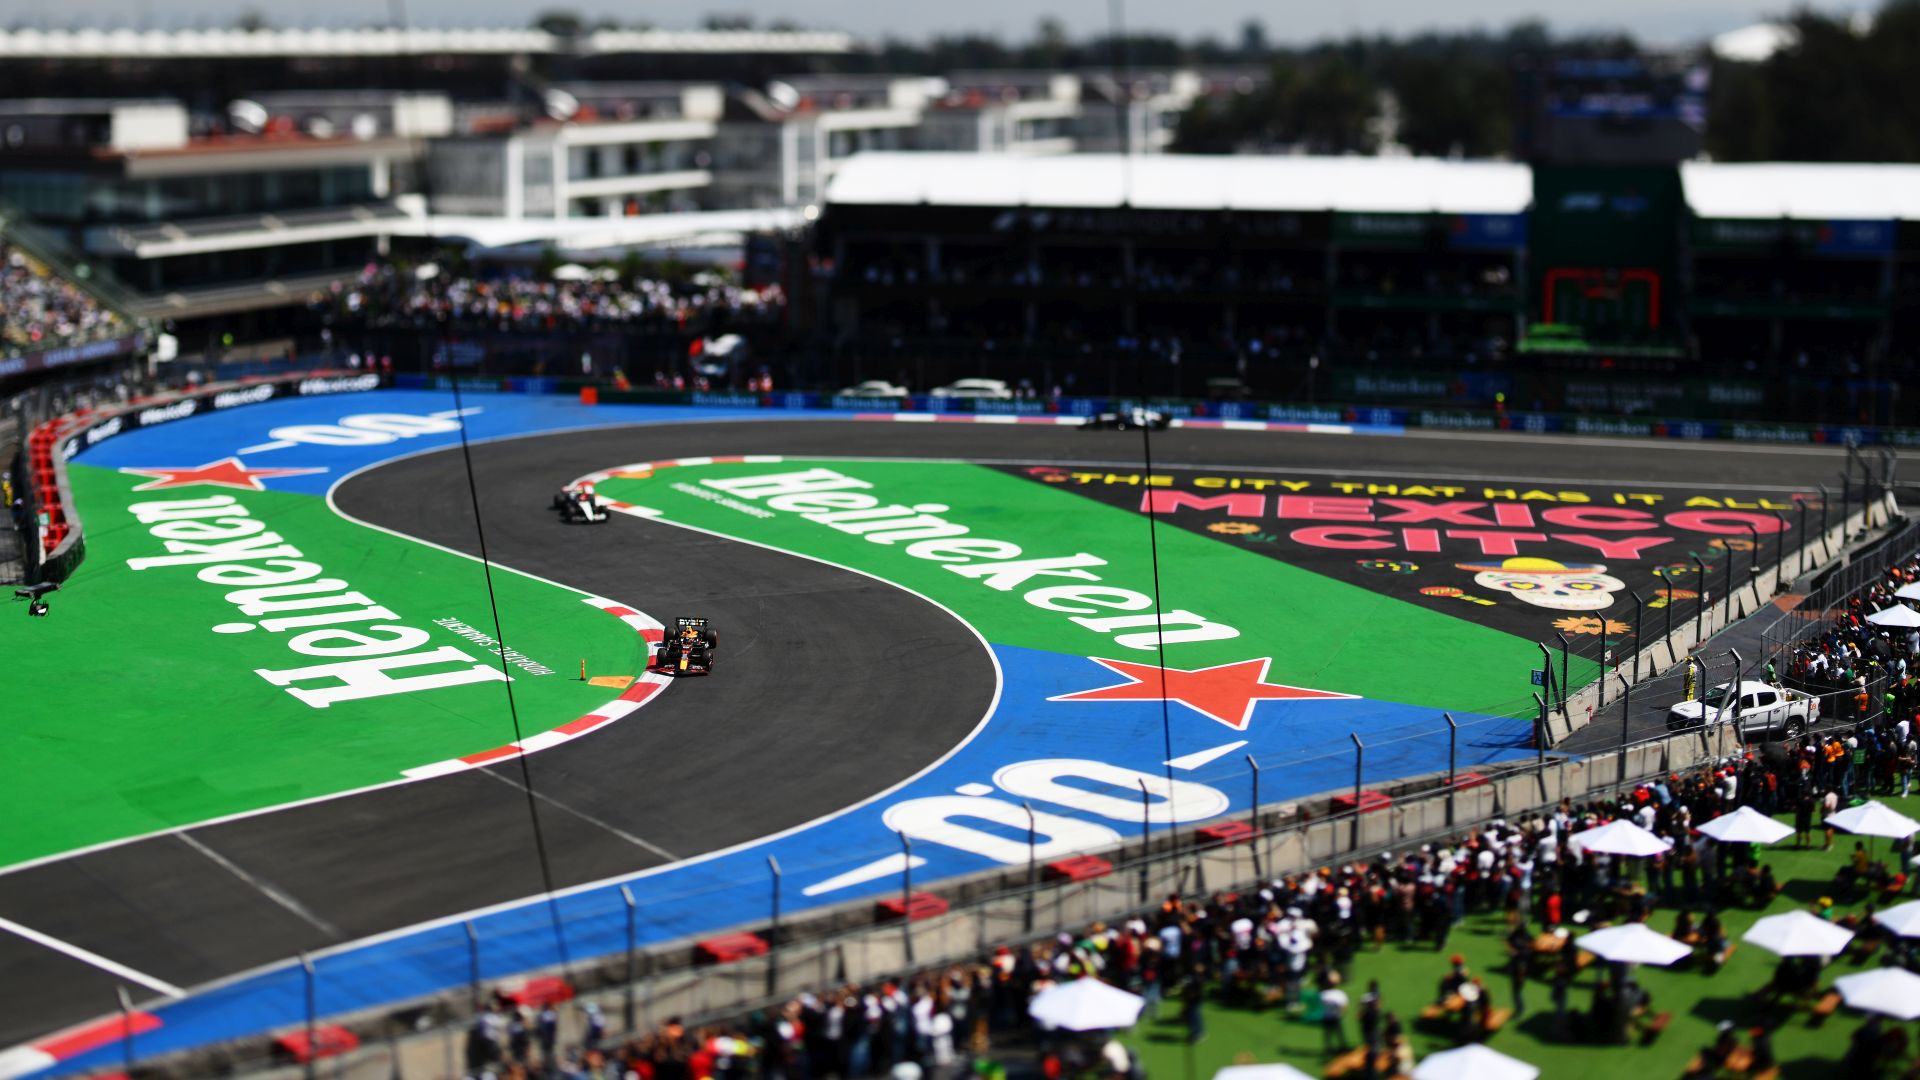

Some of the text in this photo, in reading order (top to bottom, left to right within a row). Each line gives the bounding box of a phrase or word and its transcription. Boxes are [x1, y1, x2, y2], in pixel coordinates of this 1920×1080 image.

[1071, 472, 1794, 511] THE CITY THAT HAS IT ALL
[1140, 489, 1792, 535] MEXICO
[699, 468, 1241, 651] Heineken
[1290, 525, 1675, 560] CITY
[126, 494, 516, 708] Heineken
